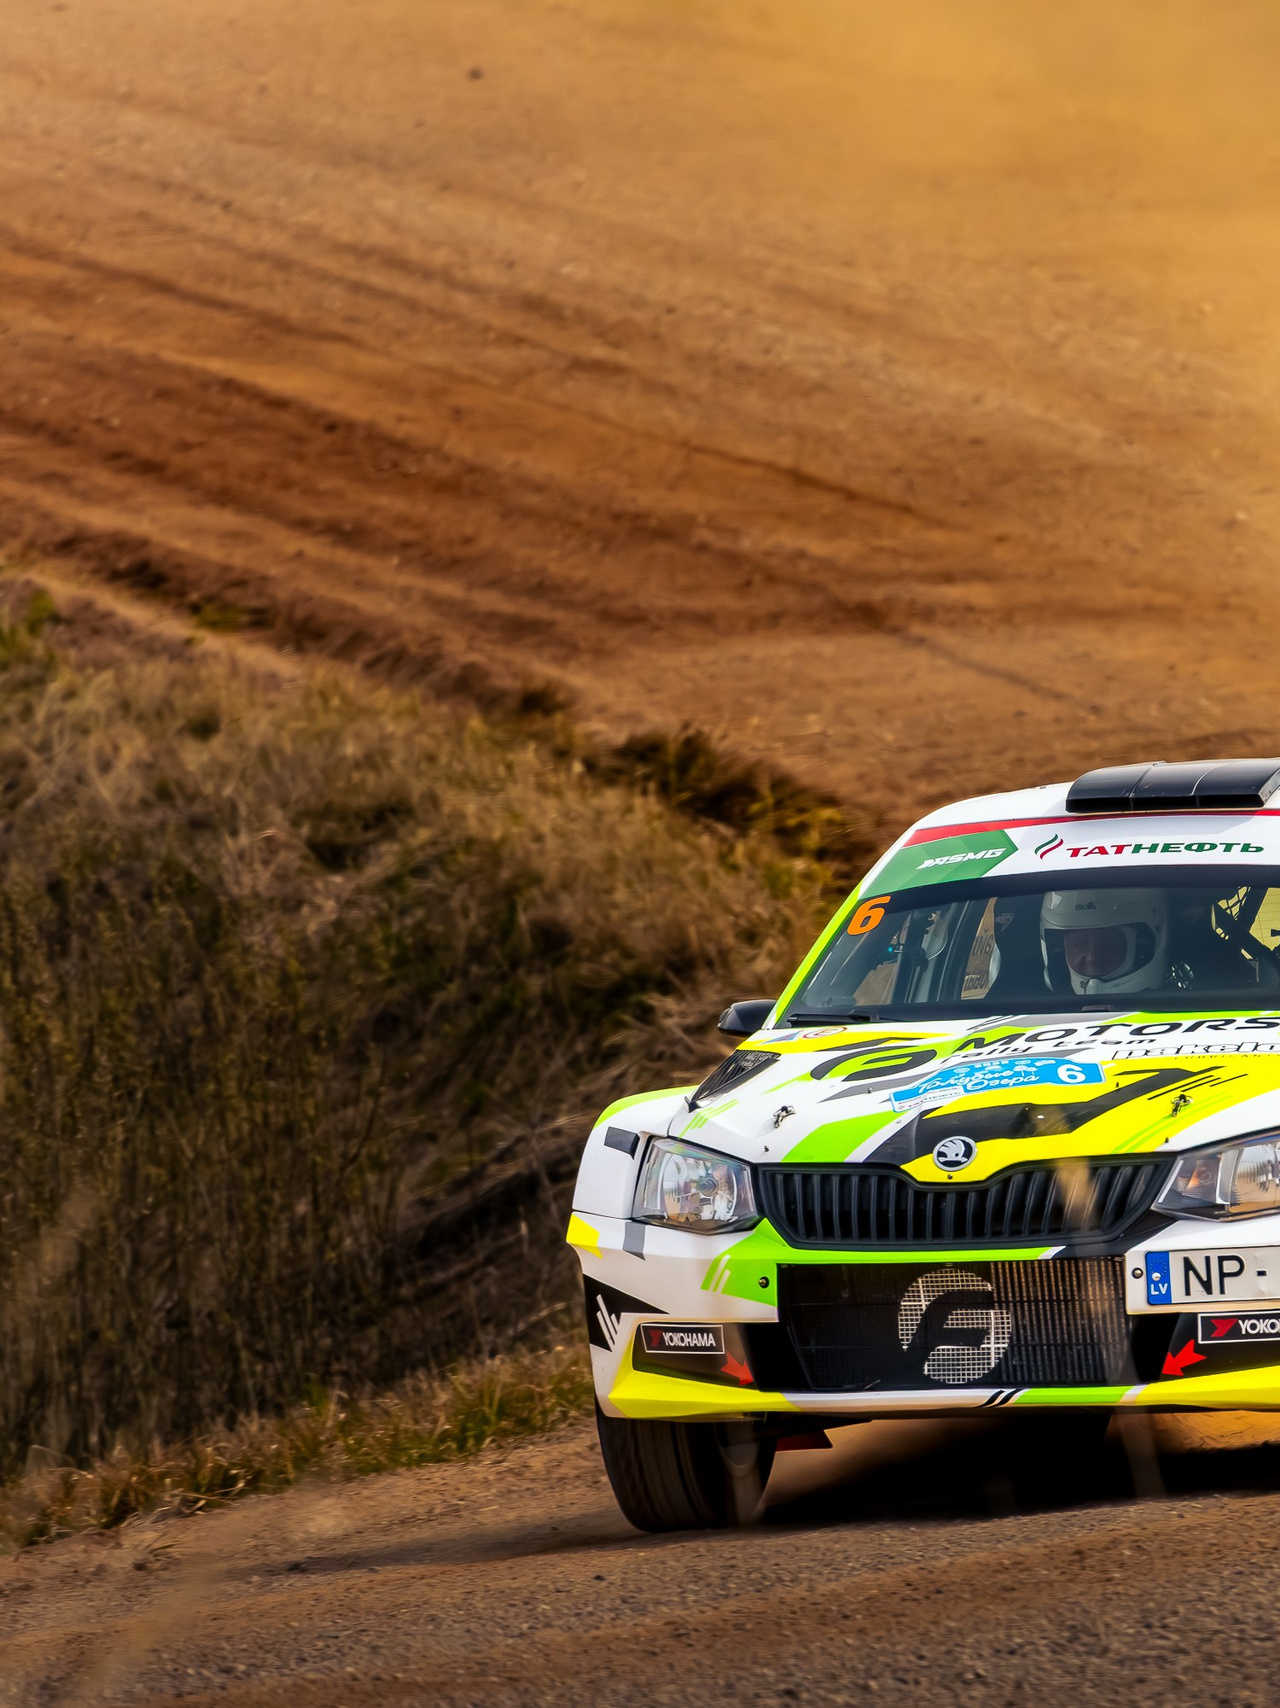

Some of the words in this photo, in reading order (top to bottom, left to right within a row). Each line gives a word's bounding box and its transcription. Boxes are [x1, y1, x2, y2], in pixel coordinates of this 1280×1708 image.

[1066, 842, 1265, 858] ТАТНЕФТЬ
[846, 896, 891, 936] 6
[941, 1045, 1033, 1064] rally
[1054, 1038, 1156, 1048] team
[917, 1068, 1014, 1093] Голубые
[1057, 1064, 1086, 1083] 6
[1150, 1283, 1168, 1296] LV
[662, 1332, 716, 1347] YOKOHAMA
